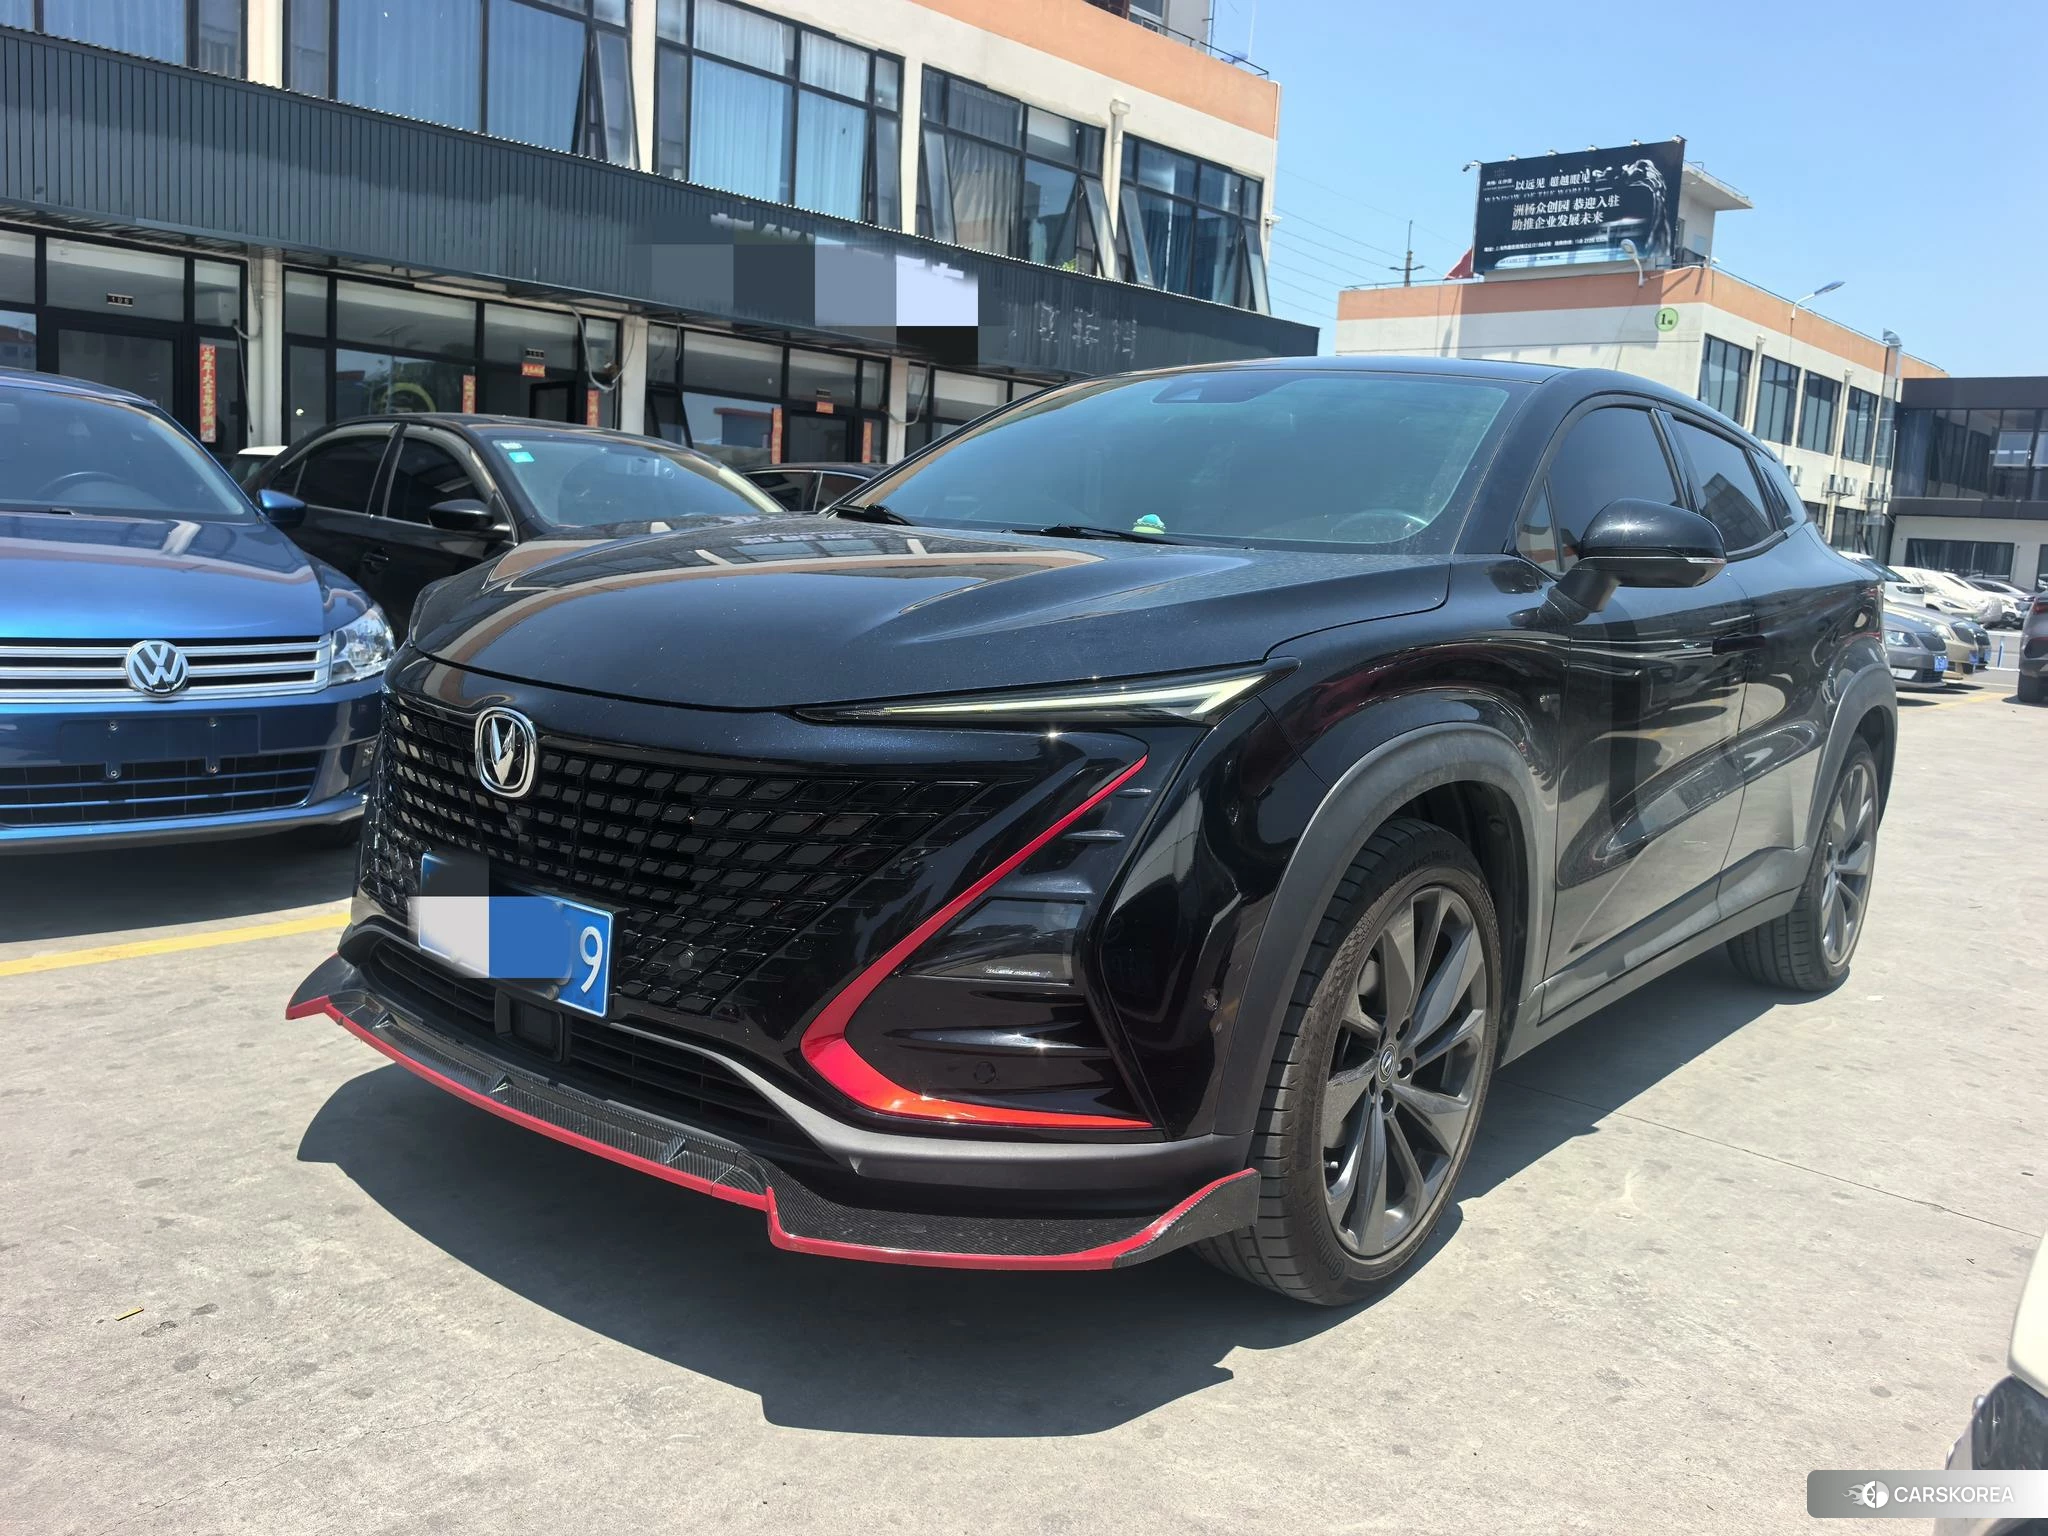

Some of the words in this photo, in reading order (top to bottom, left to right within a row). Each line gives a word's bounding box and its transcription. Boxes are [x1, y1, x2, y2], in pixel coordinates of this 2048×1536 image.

[1573, 194, 1621, 210] 恭迎入驻
[1511, 211, 1604, 231] 助推企业发展未来
